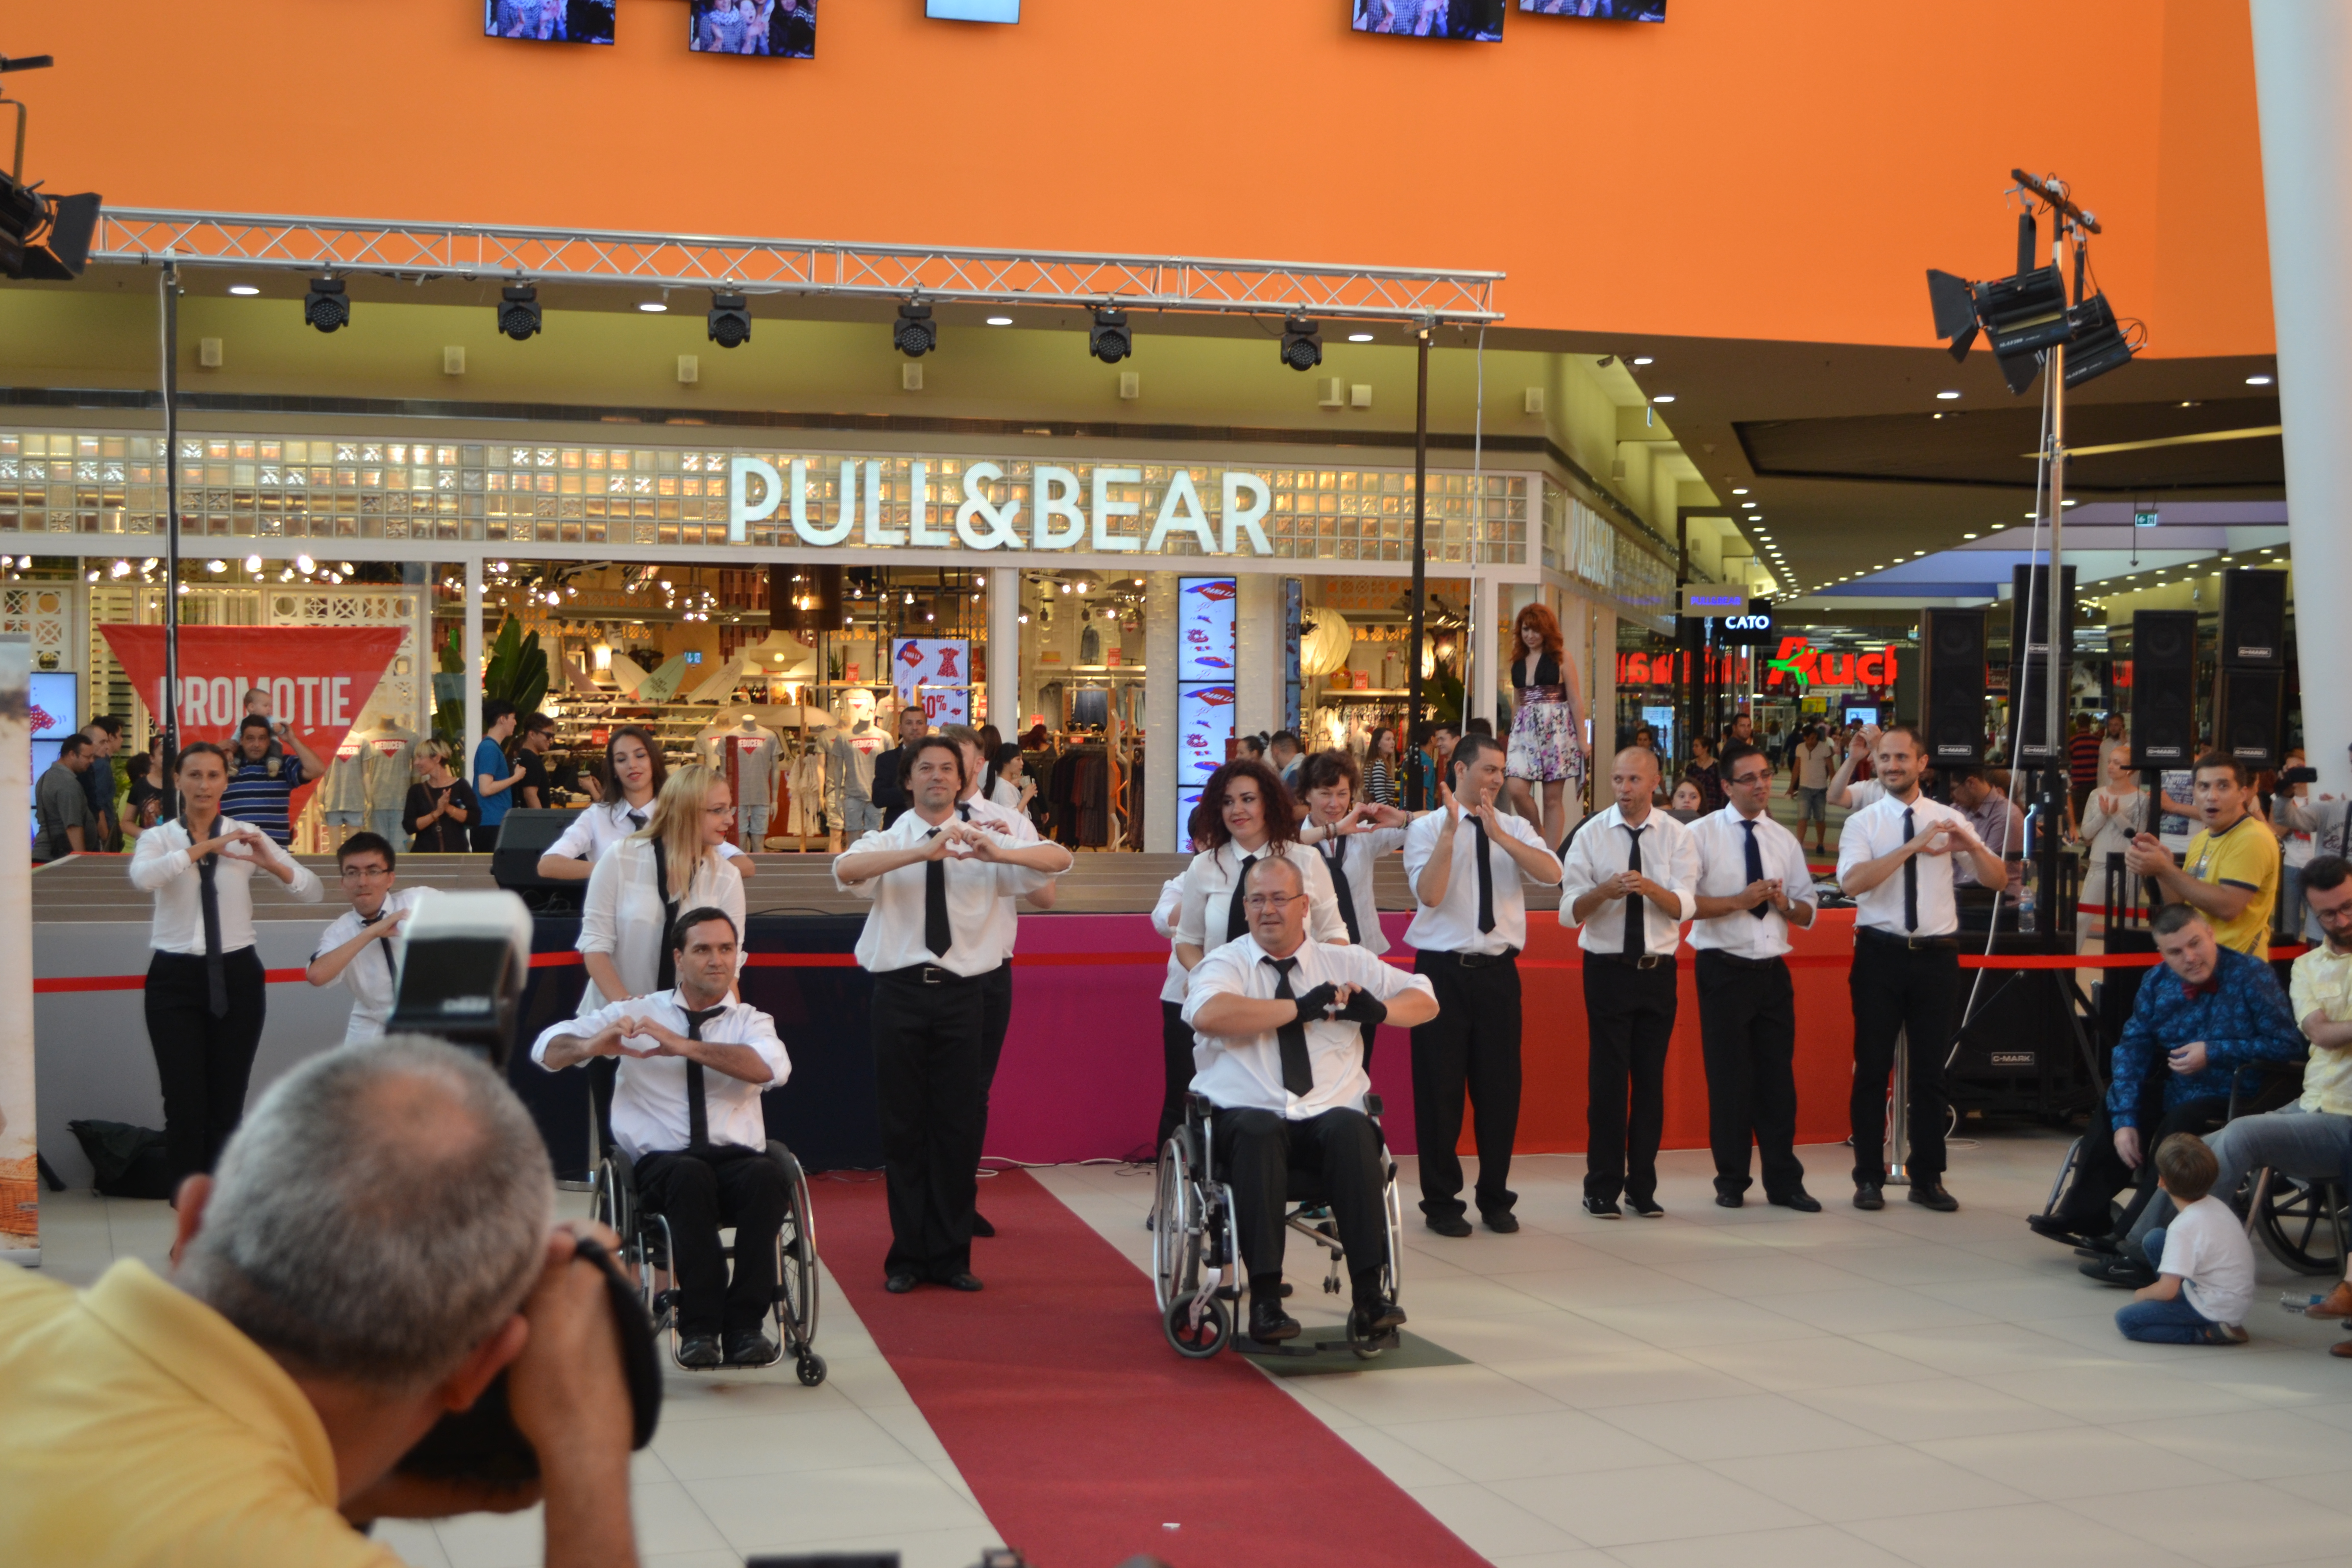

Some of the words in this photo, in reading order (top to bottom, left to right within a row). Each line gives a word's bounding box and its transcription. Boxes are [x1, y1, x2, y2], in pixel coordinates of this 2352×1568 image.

[730, 456, 1274, 555] PULL&BEAR
[1690, 596, 1741, 606] PULL&BEAR
[1725, 616, 1769, 629] CATO
[336, 746, 359, 755] DUCERI
